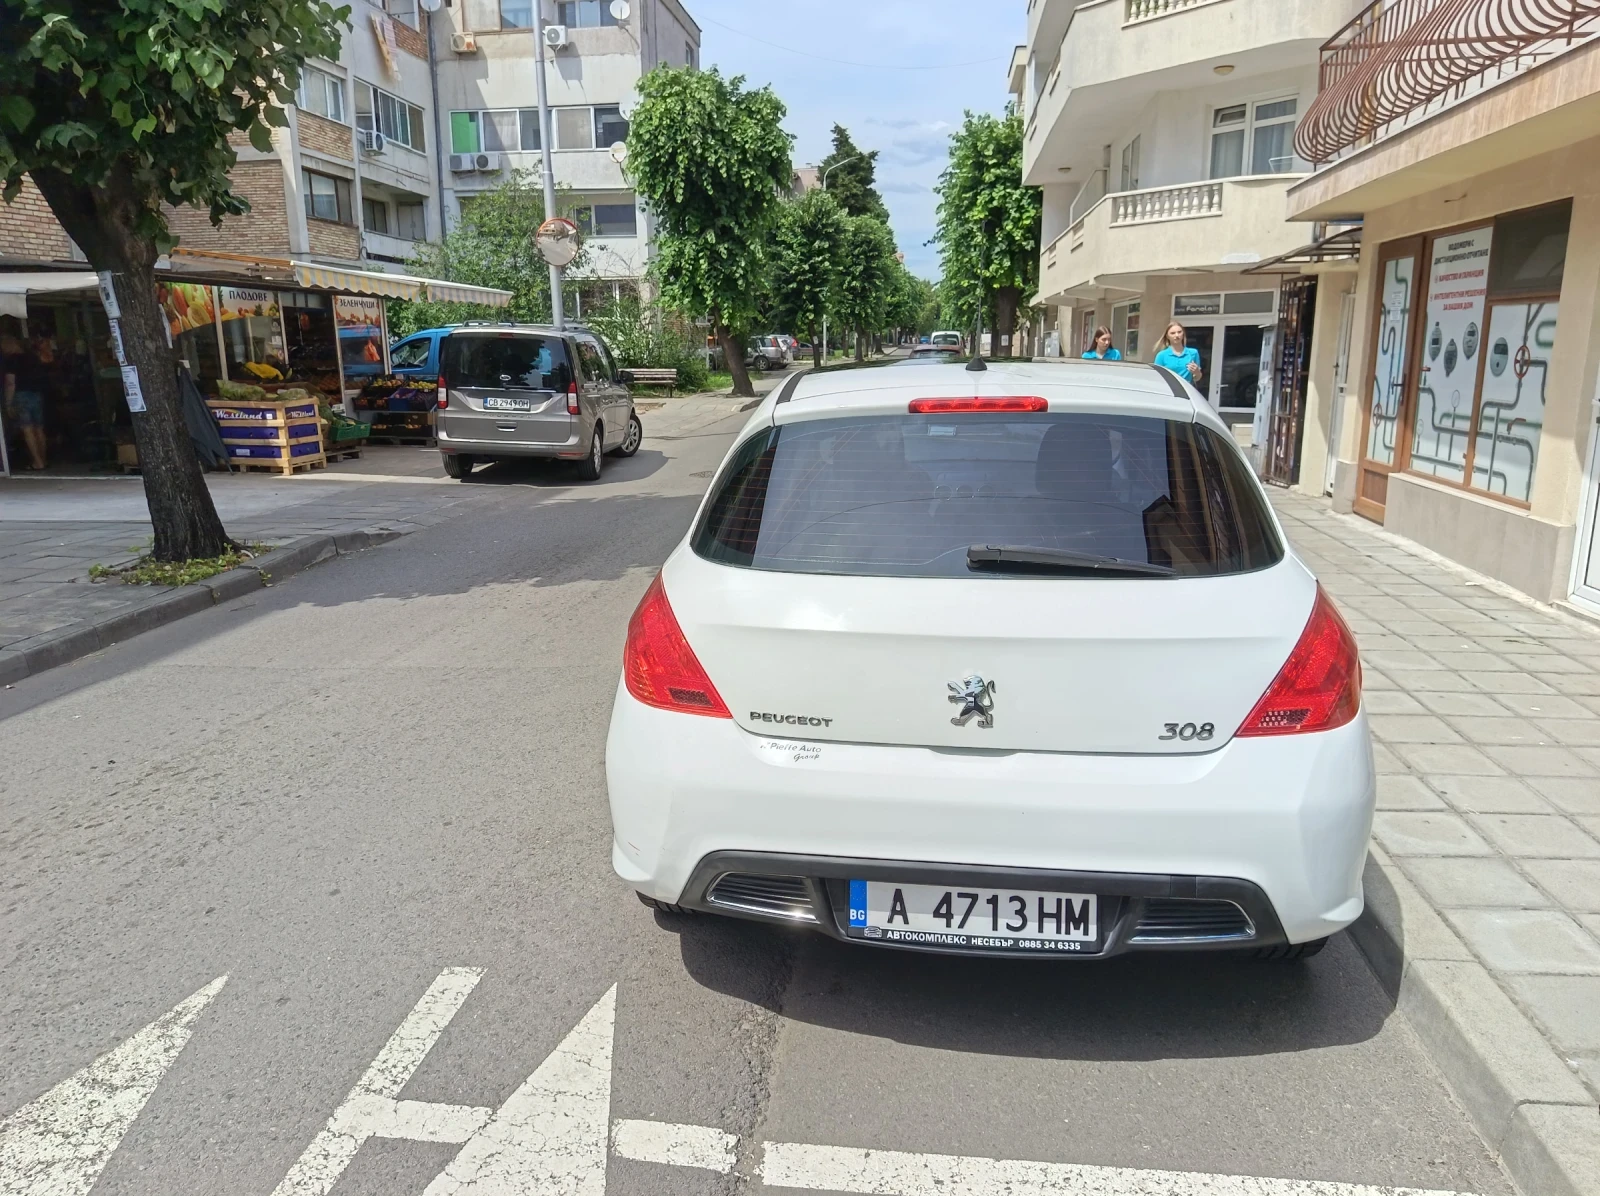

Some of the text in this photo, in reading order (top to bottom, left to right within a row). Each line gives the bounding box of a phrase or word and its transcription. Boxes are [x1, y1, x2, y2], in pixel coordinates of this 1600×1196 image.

[229, 290, 268, 302] ПЛОДОВЕ
[339, 298, 375, 309] ЗЕЛЕНЧУЦИ
[215, 409, 263, 420] Westland
[750, 711, 833, 728] PEUGEOT
[1158, 722, 1215, 741] 308
[799, 744, 822, 753] Auto
[850, 909, 865, 921] BG
[887, 888, 1090, 937] A 4713 HM
[886, 930, 1081, 950] АВТОКОМПЛЕКС НЕСЕБЪР 0885 34 6335
